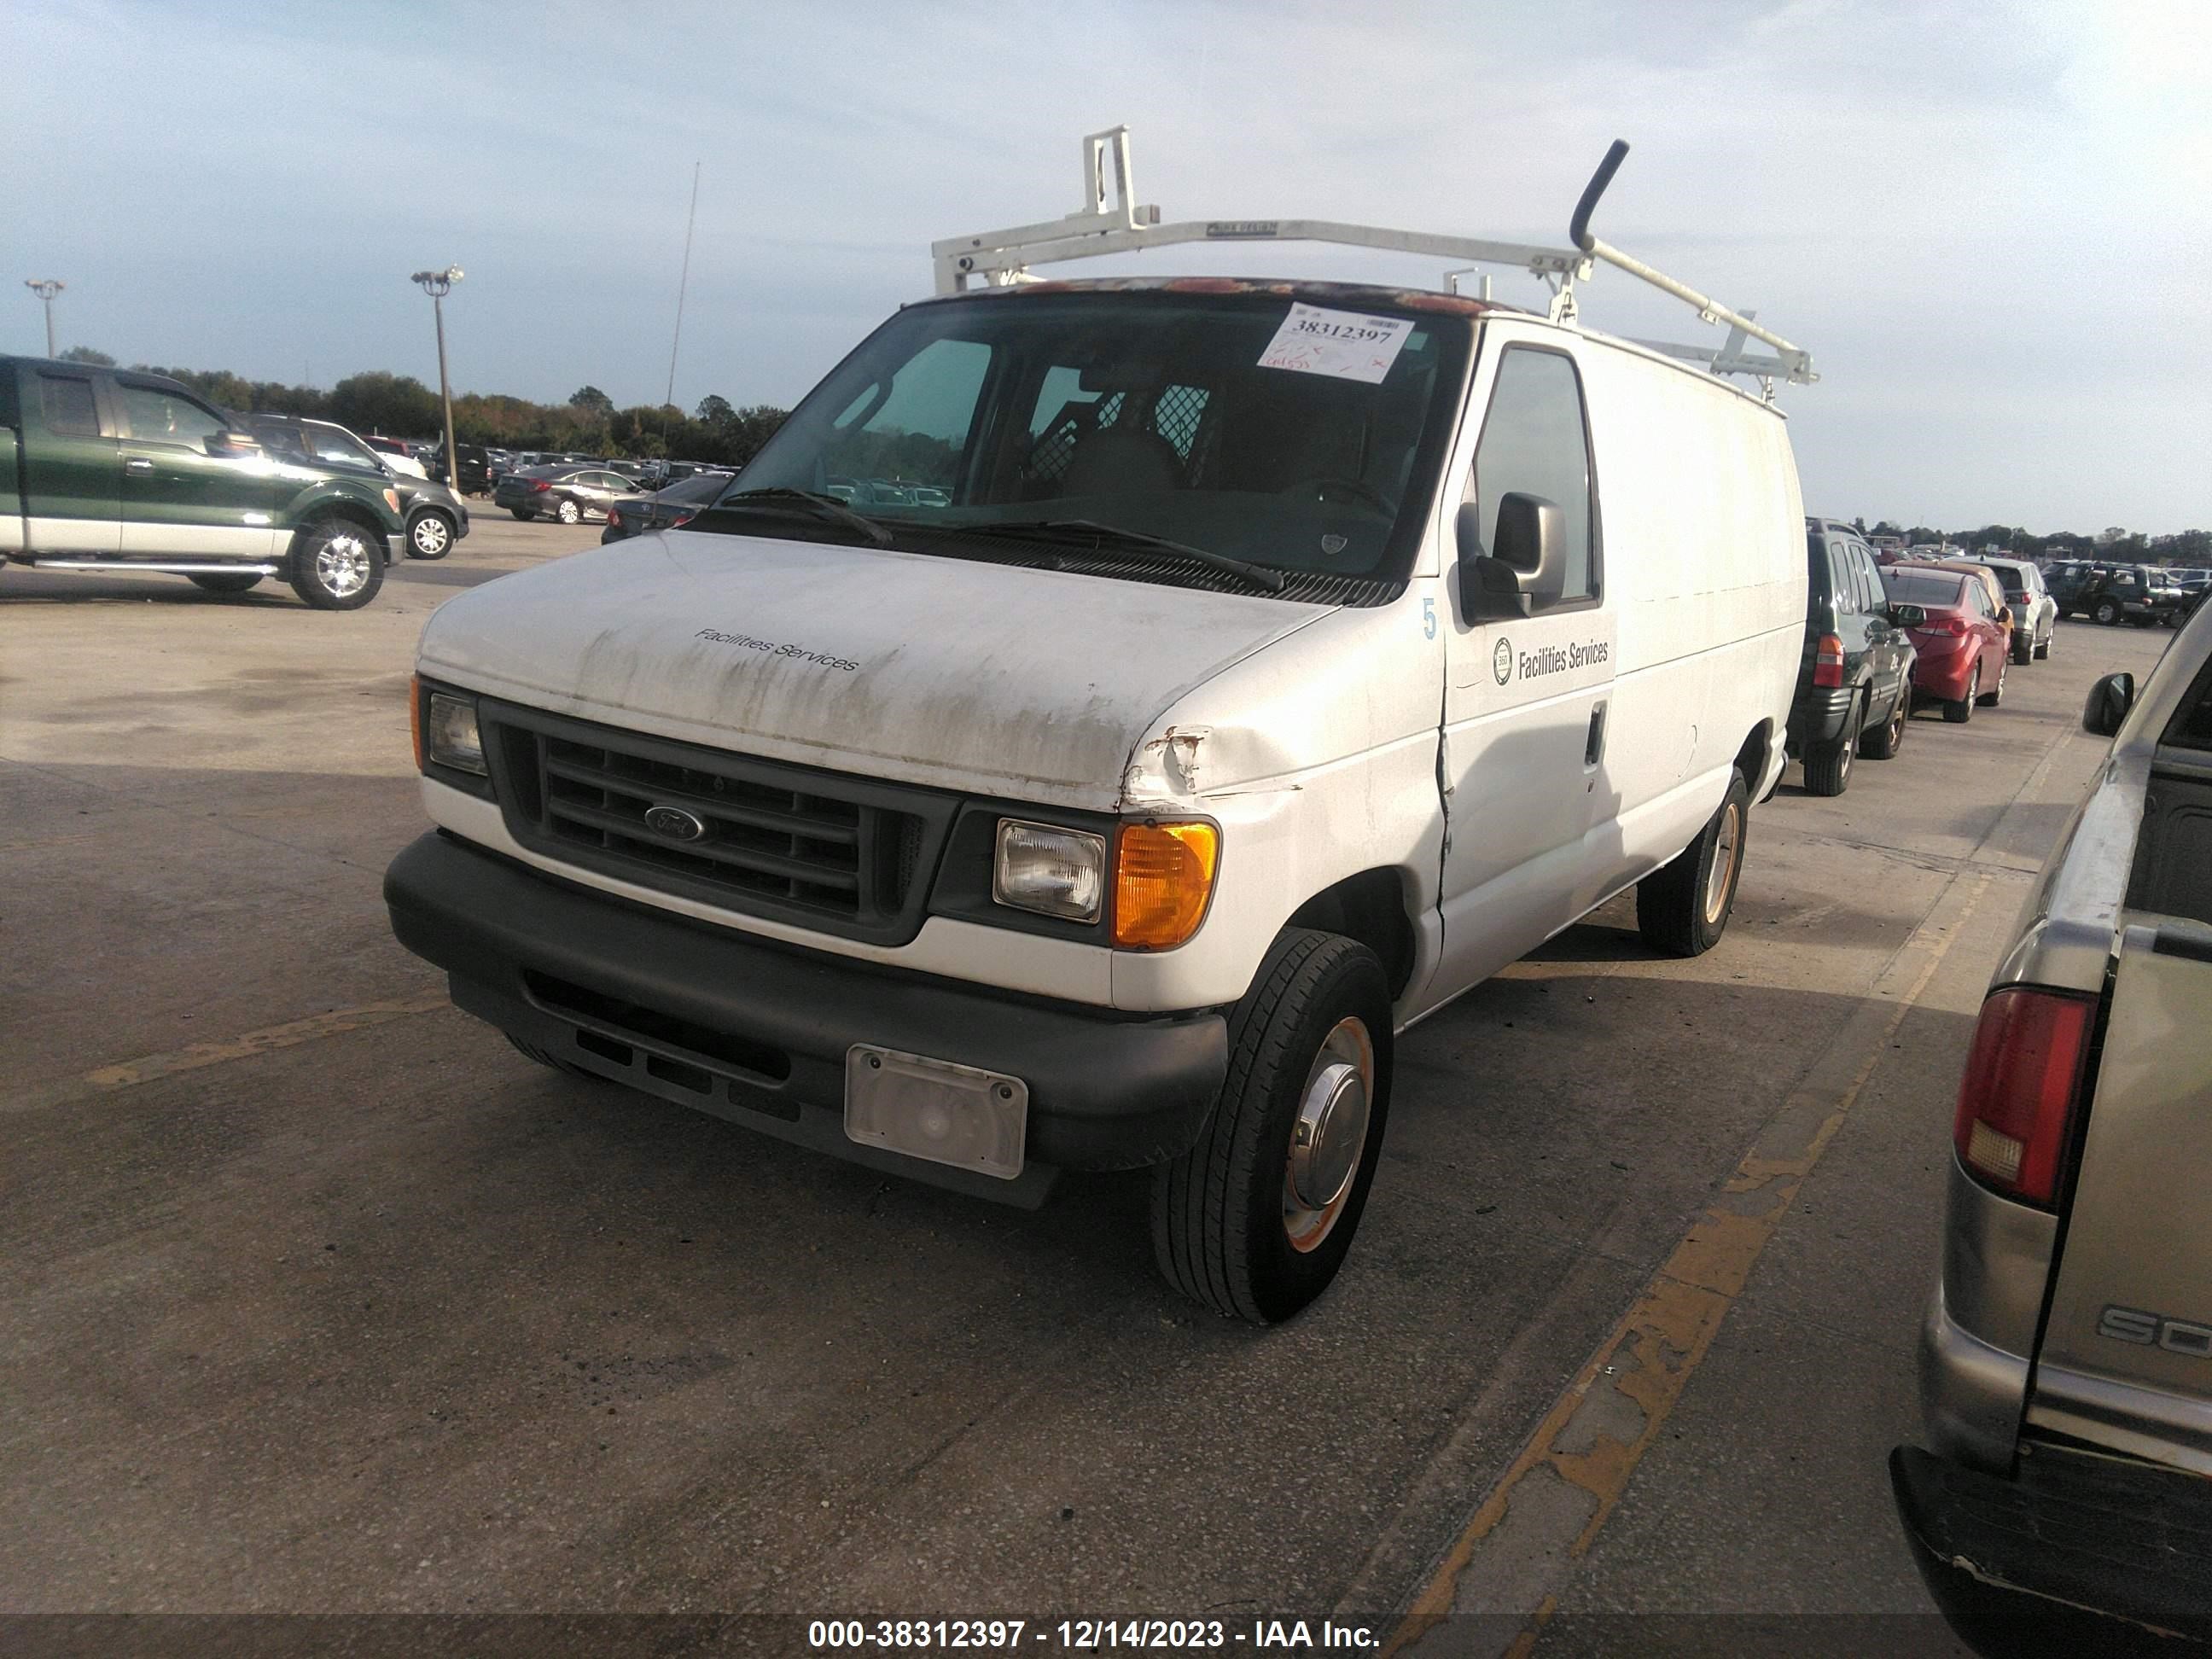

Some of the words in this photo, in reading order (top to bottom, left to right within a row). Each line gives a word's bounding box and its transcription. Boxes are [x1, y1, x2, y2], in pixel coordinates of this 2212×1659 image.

[1292, 319, 1392, 344] 38312397
[1423, 597, 1436, 640] 5
[695, 628, 774, 651] Facilities
[774, 643, 859, 672] Services
[1518, 646, 1566, 680] Facilities
[1569, 637, 1609, 670] Services
